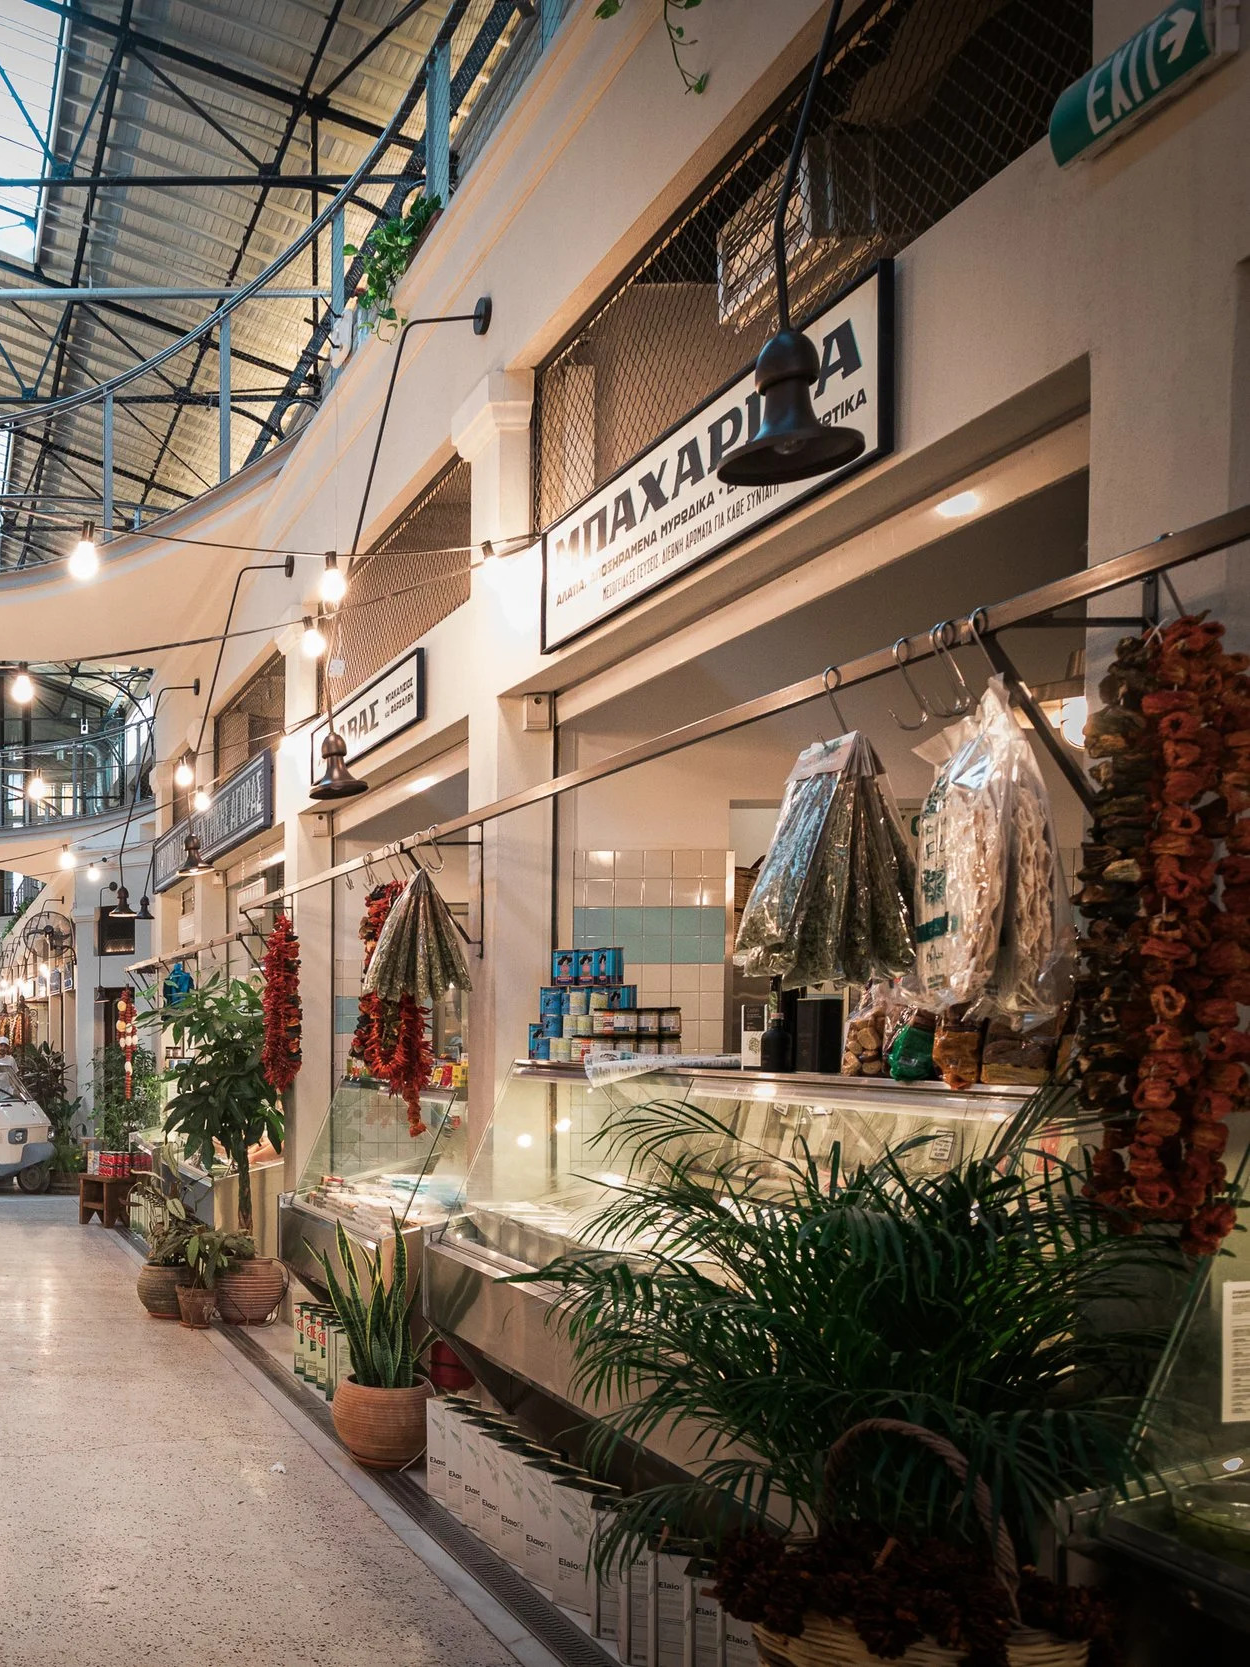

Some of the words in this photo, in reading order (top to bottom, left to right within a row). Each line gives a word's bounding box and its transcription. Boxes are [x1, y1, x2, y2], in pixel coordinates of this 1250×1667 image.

[1087, 13, 1168, 135] EXIT
[555, 318, 862, 562] ΜΠΑΧΑΡΙΑ
[661, 491, 715, 539] ΜΥΡΩΔΙΚΑ
[715, 511, 724, 532] ΓΙΑ
[727, 498, 745, 523] ΚΑΘΕ
